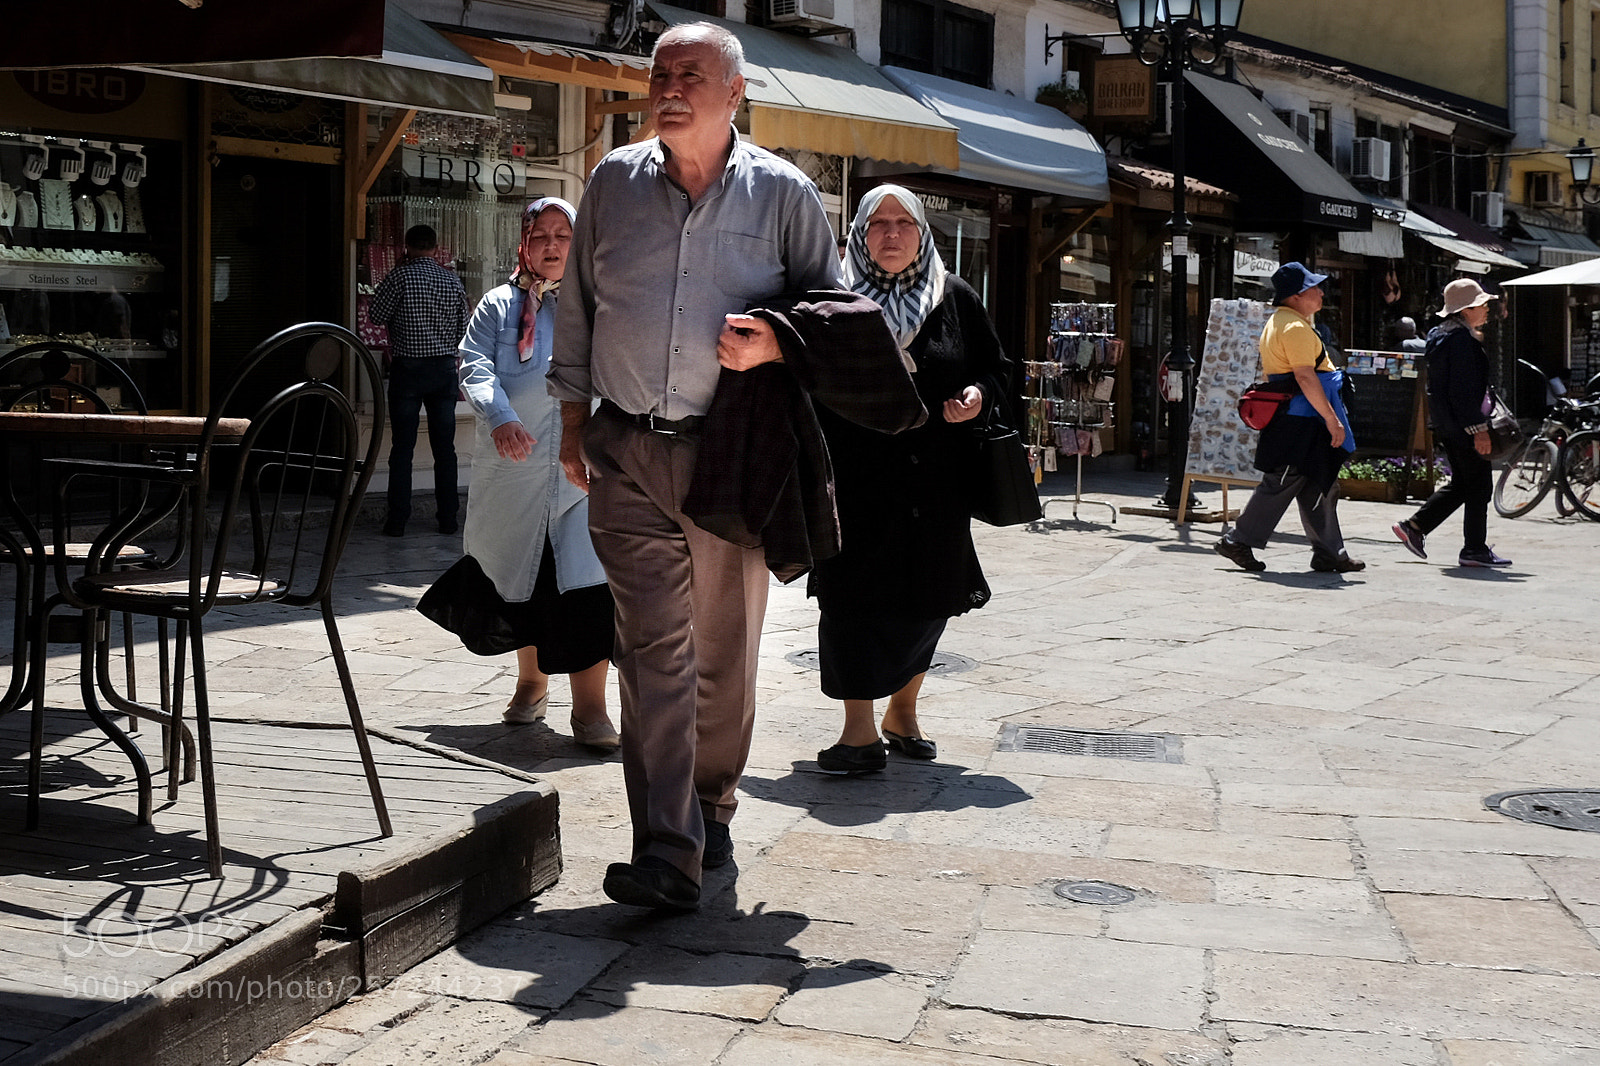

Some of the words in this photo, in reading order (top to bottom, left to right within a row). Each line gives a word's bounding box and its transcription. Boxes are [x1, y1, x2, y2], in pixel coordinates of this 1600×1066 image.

[33, 70, 127, 101] IBRO
[1098, 82, 1145, 98] BALKAN
[418, 154, 516, 195] IBRO
[1325, 203, 1353, 218] GAUCHE
[28, 273, 70, 286] Stainless
[76, 274, 98, 286] Steel
